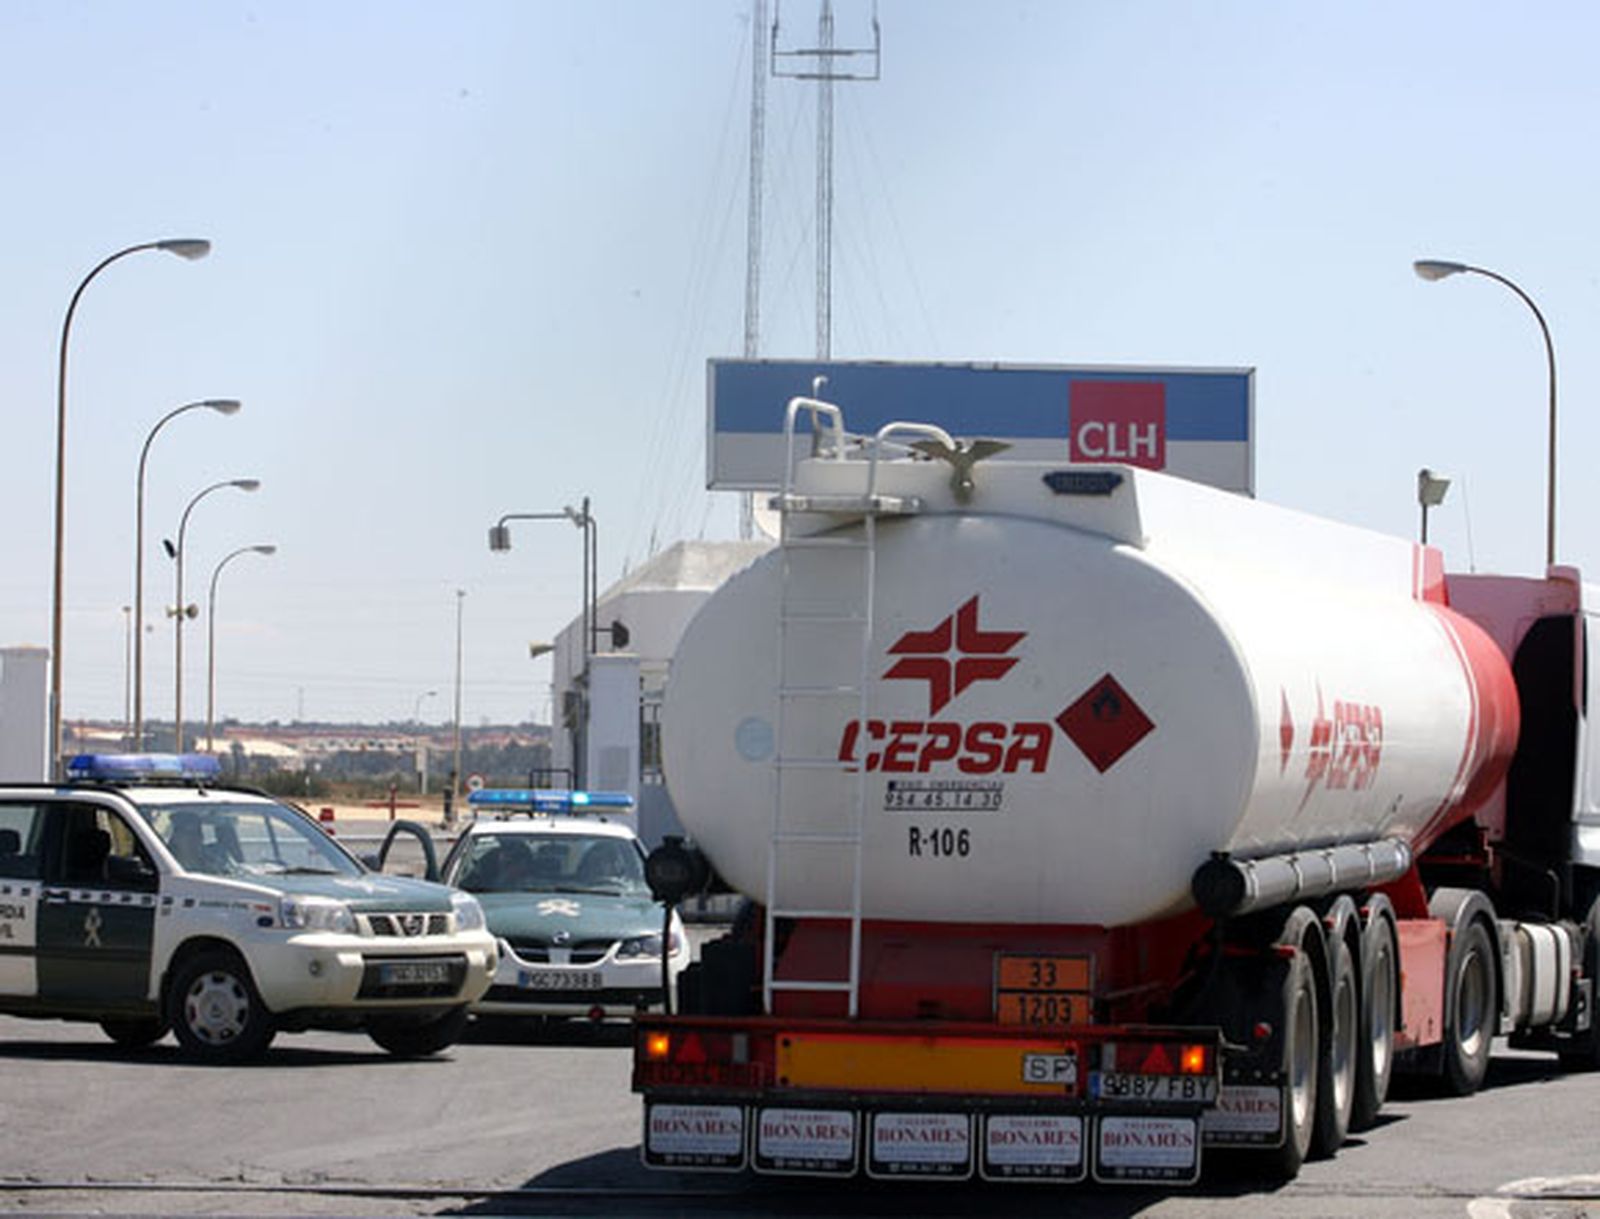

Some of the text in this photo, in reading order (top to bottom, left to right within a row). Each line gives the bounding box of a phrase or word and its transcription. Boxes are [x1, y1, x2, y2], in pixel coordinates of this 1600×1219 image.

[1077, 421, 1157, 458] CLH
[838, 720, 1054, 774] CEPSA
[1029, 961, 1057, 987] 33
[1018, 997, 1072, 1025] 1203
[1029, 1058, 1072, 1080] SP
[1168, 1077, 1212, 1100] FBY
[1220, 1099, 1279, 1114] NARES
[653, 1119, 740, 1134] BONARES
[763, 1123, 850, 1140] BONARES
[877, 1128, 967, 1143] BONARES
[991, 1130, 1079, 1145] BONARES
[1104, 1131, 1192, 1147] BONARES
